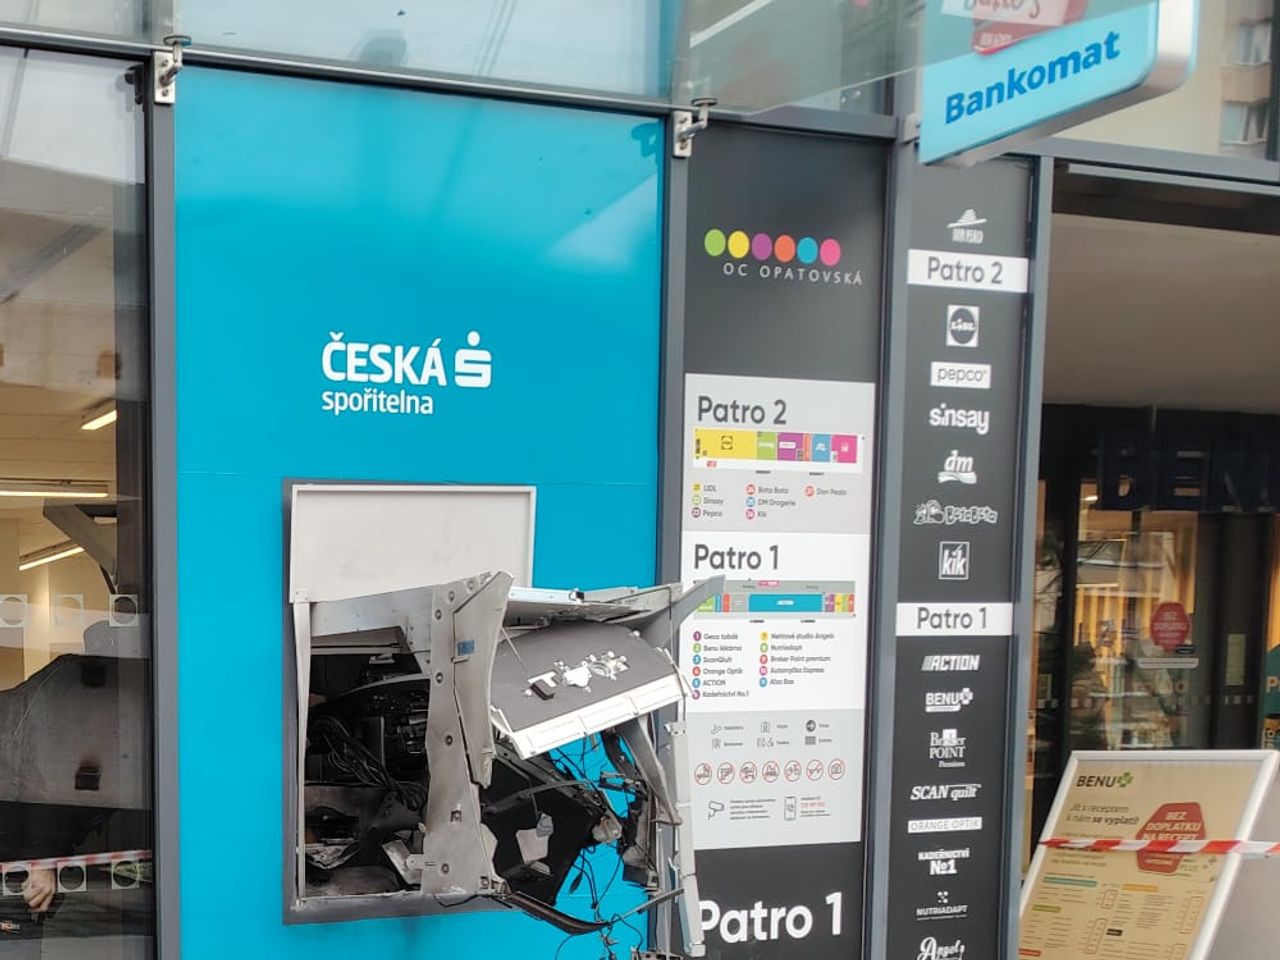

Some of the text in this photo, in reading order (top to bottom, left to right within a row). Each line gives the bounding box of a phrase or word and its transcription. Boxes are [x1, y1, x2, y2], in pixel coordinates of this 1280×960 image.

[945, 31, 1120, 124] Bankomat
[723, 262, 862, 285] OC OPATOVSKÁ
[927, 256, 1003, 285] Patro 2
[321, 331, 447, 386] ČESKÁ
[321, 387, 434, 416] spořitelna
[697, 395, 787, 426] Patro 2
[929, 402, 990, 435] sinsay
[943, 450, 974, 473] dm
[694, 544, 779, 570] Patro 1
[942, 544, 966, 576] kik
[917, 606, 987, 629] Patro 1
[930, 655, 981, 671] ACTION
[925, 692, 960, 706] BENU
[929, 746, 966, 759] POINT
[910, 785, 949, 800] SCAN
[1076, 775, 1117, 788] BENU
[910, 820, 949, 831] ORANGE
[1145, 821, 1202, 832] DOPLATKU
[699, 891, 842, 944] Patro 1
[916, 904, 968, 916] NUTRIADAPT
